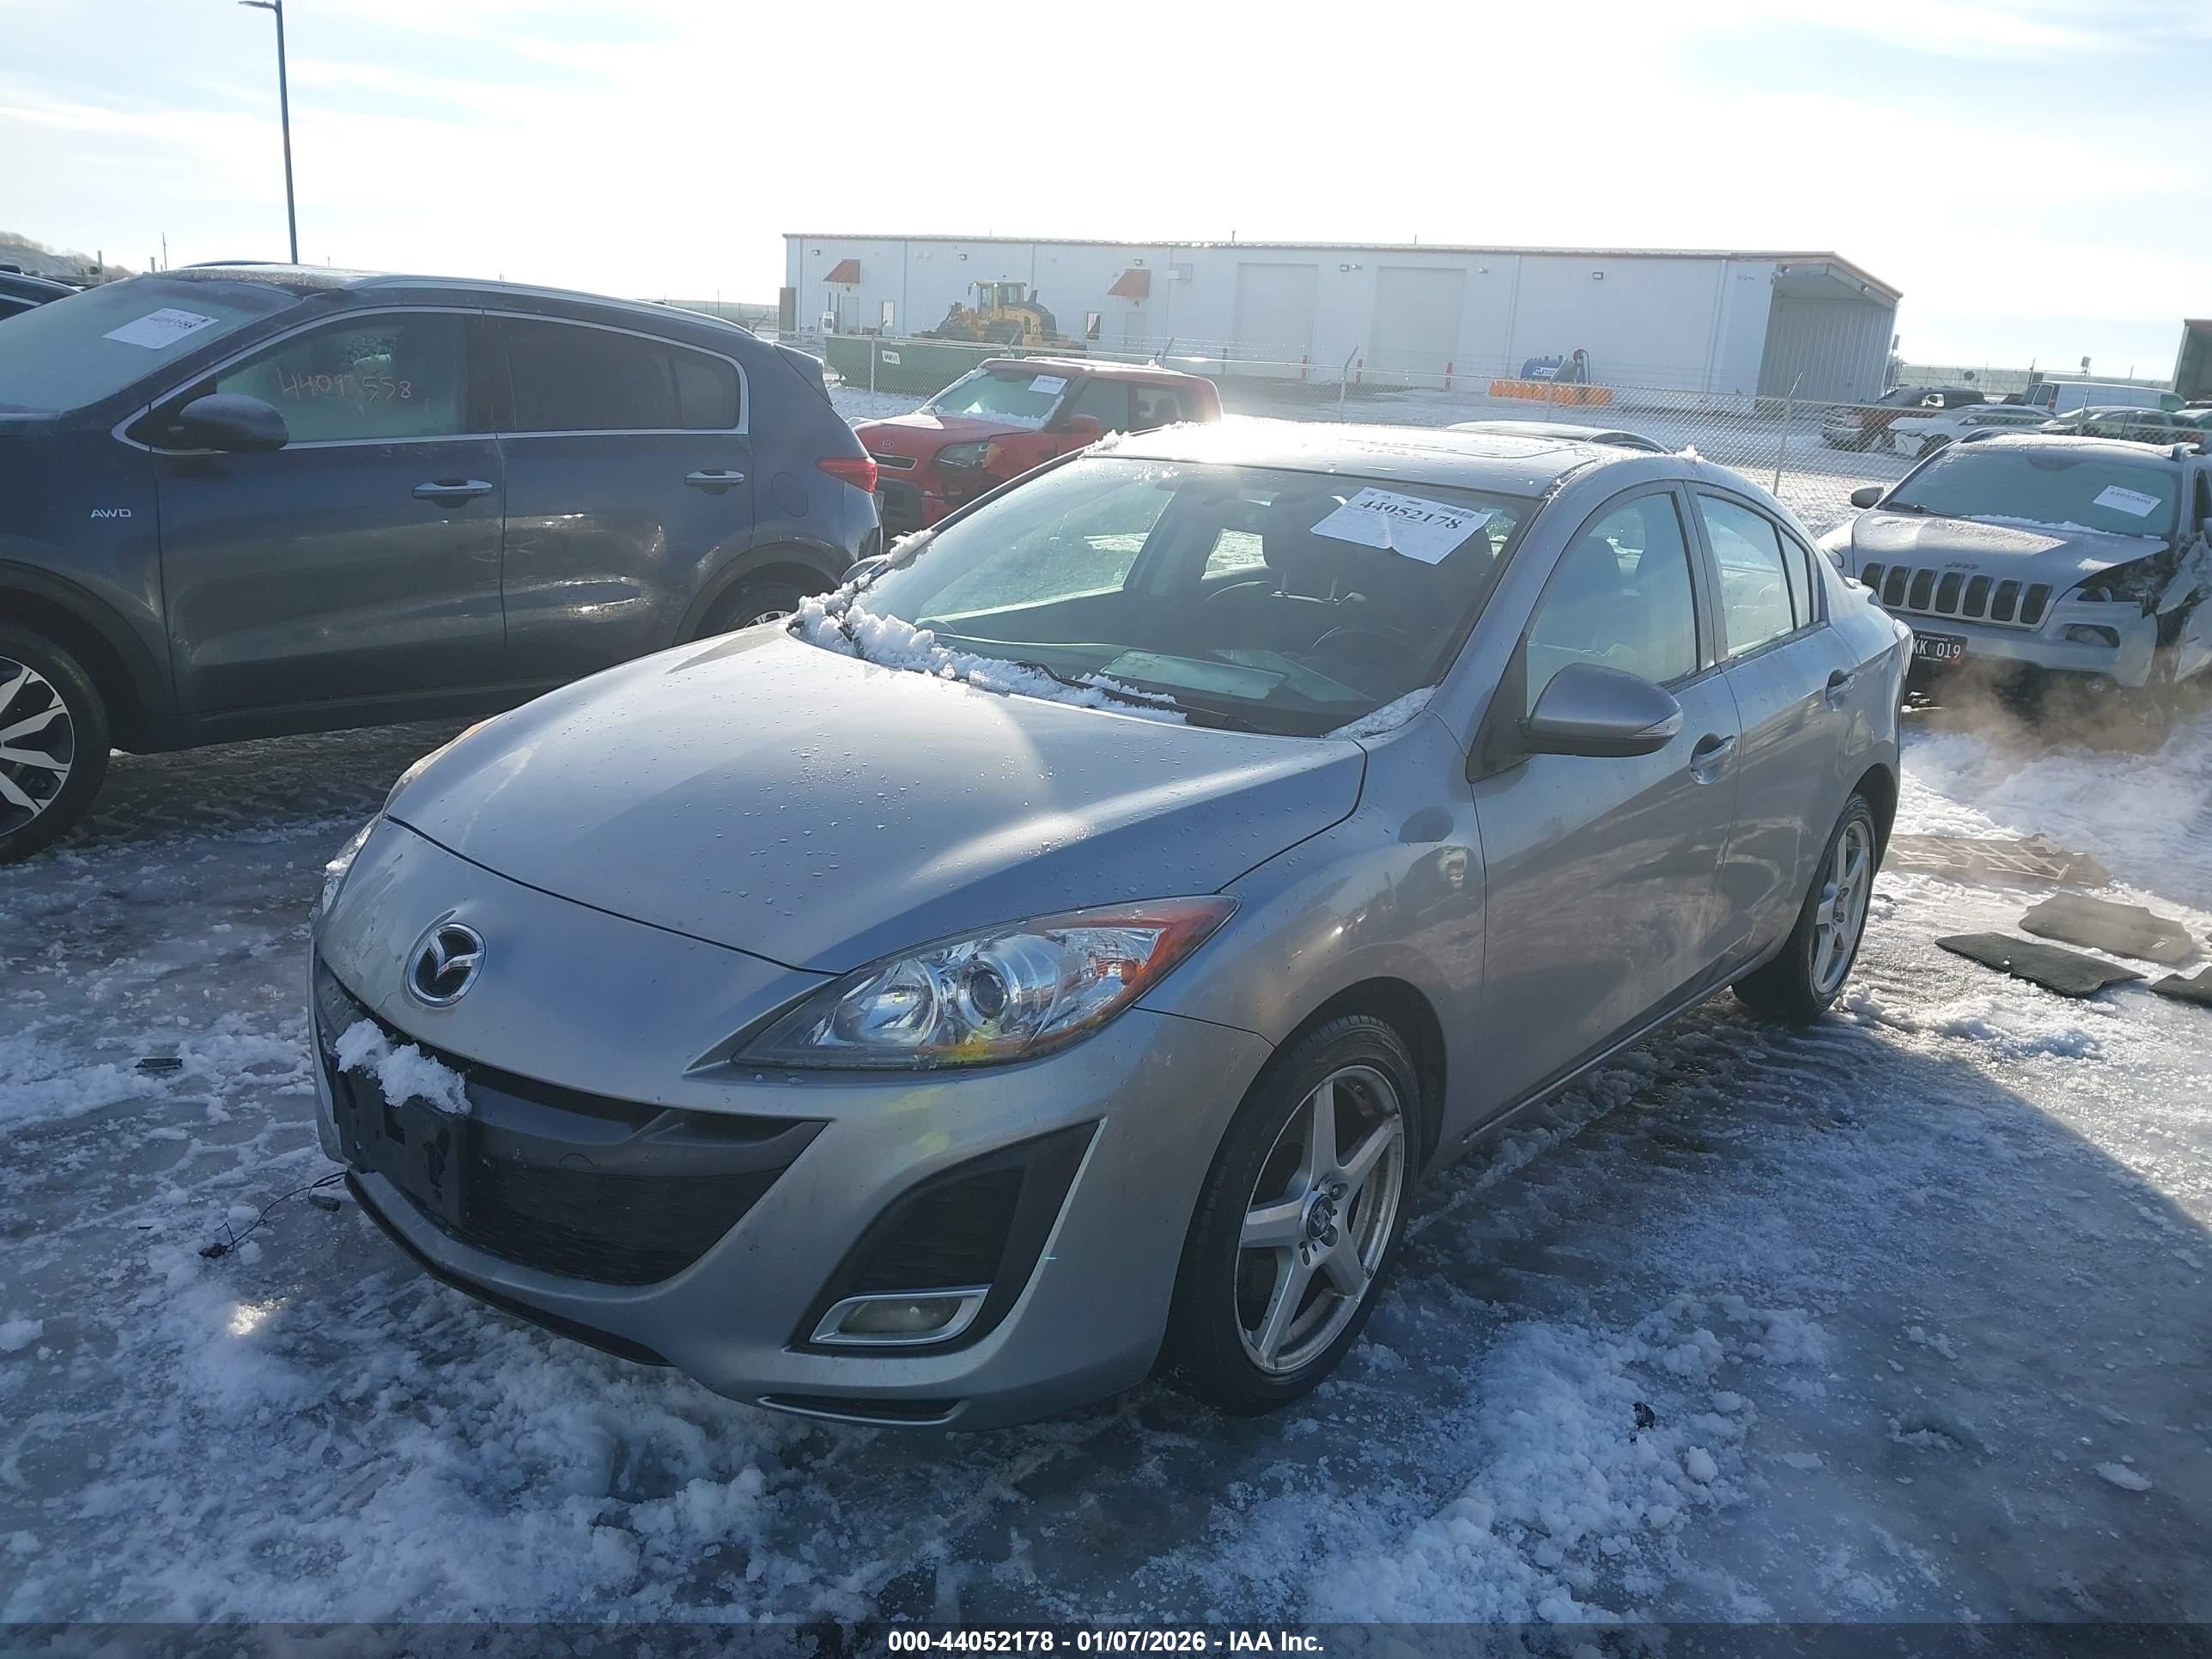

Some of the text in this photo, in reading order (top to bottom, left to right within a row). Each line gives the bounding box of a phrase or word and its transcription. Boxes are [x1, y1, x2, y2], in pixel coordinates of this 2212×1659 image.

[90, 508, 131, 519] AWD
[1359, 500, 1462, 530] 44052178
[1936, 642, 1962, 659] 019
